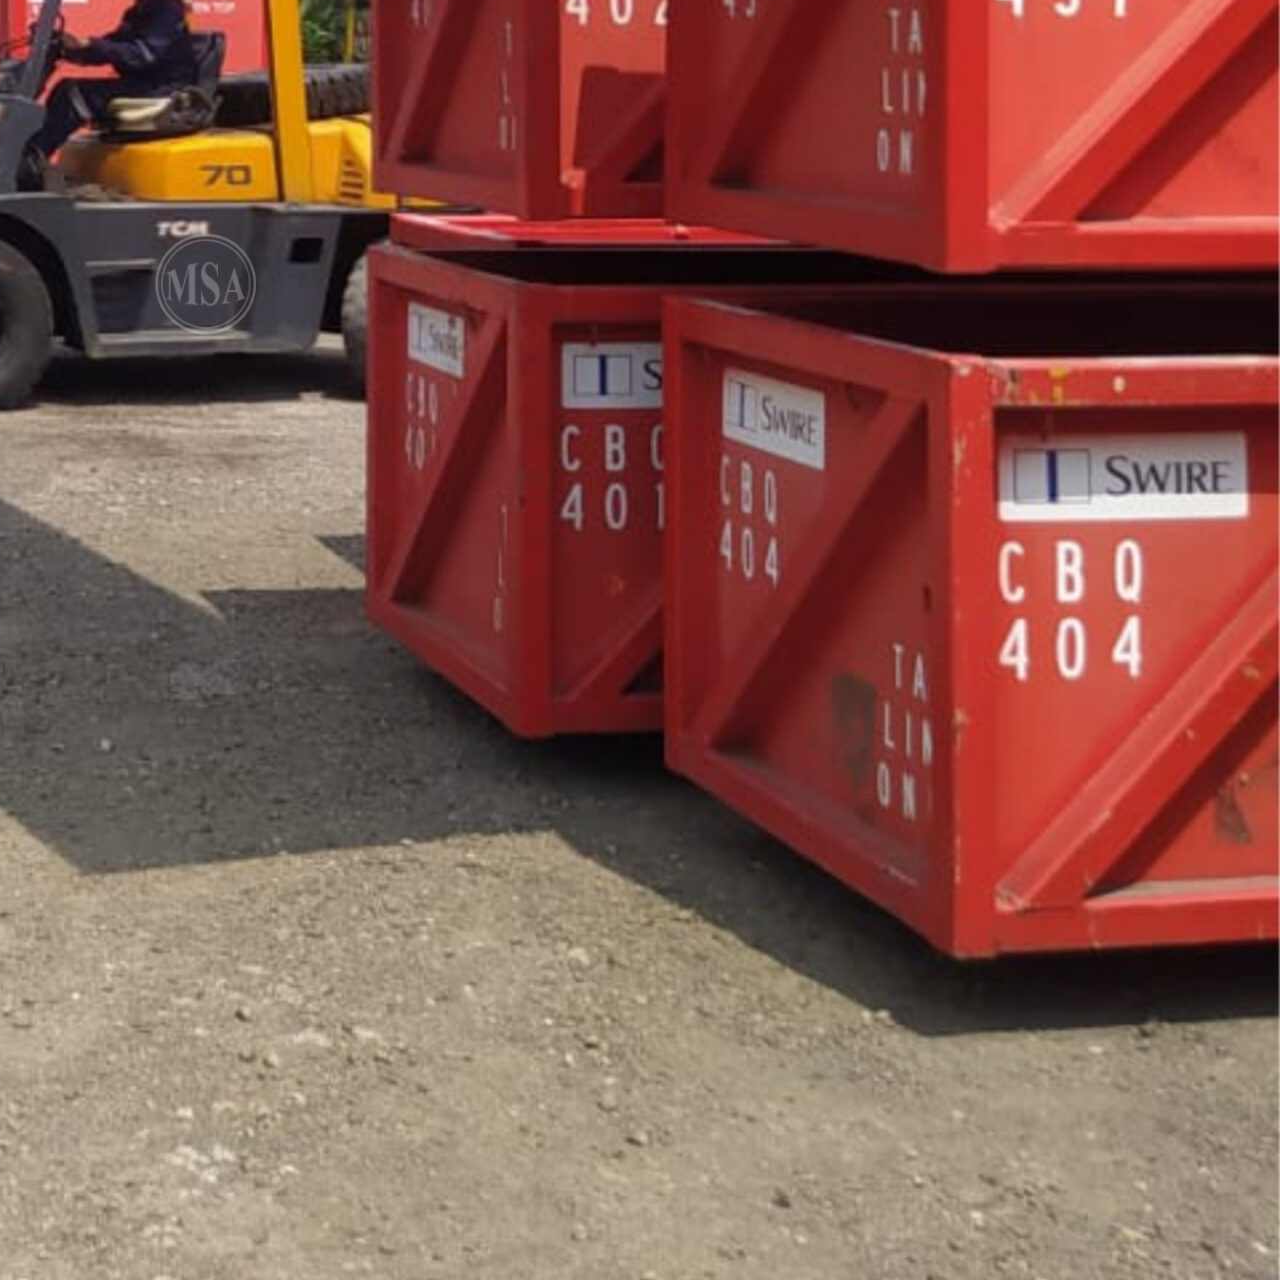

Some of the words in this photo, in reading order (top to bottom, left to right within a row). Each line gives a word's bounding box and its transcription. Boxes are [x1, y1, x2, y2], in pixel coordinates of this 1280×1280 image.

[888, 7, 923, 55] TA
[199, 164, 252, 187] 70
[876, 129, 913, 175] ON
[760, 396, 819, 448] SWIRE
[719, 454, 779, 524] CBQ
[1103, 454, 1235, 498] SWIRE
[718, 518, 780, 588] 404
[997, 539, 1144, 605] CBQ
[892, 642, 928, 702] TA
[998, 615, 1144, 682] 404
[883, 701, 934, 766] LIN
[876, 761, 917, 821] ON
